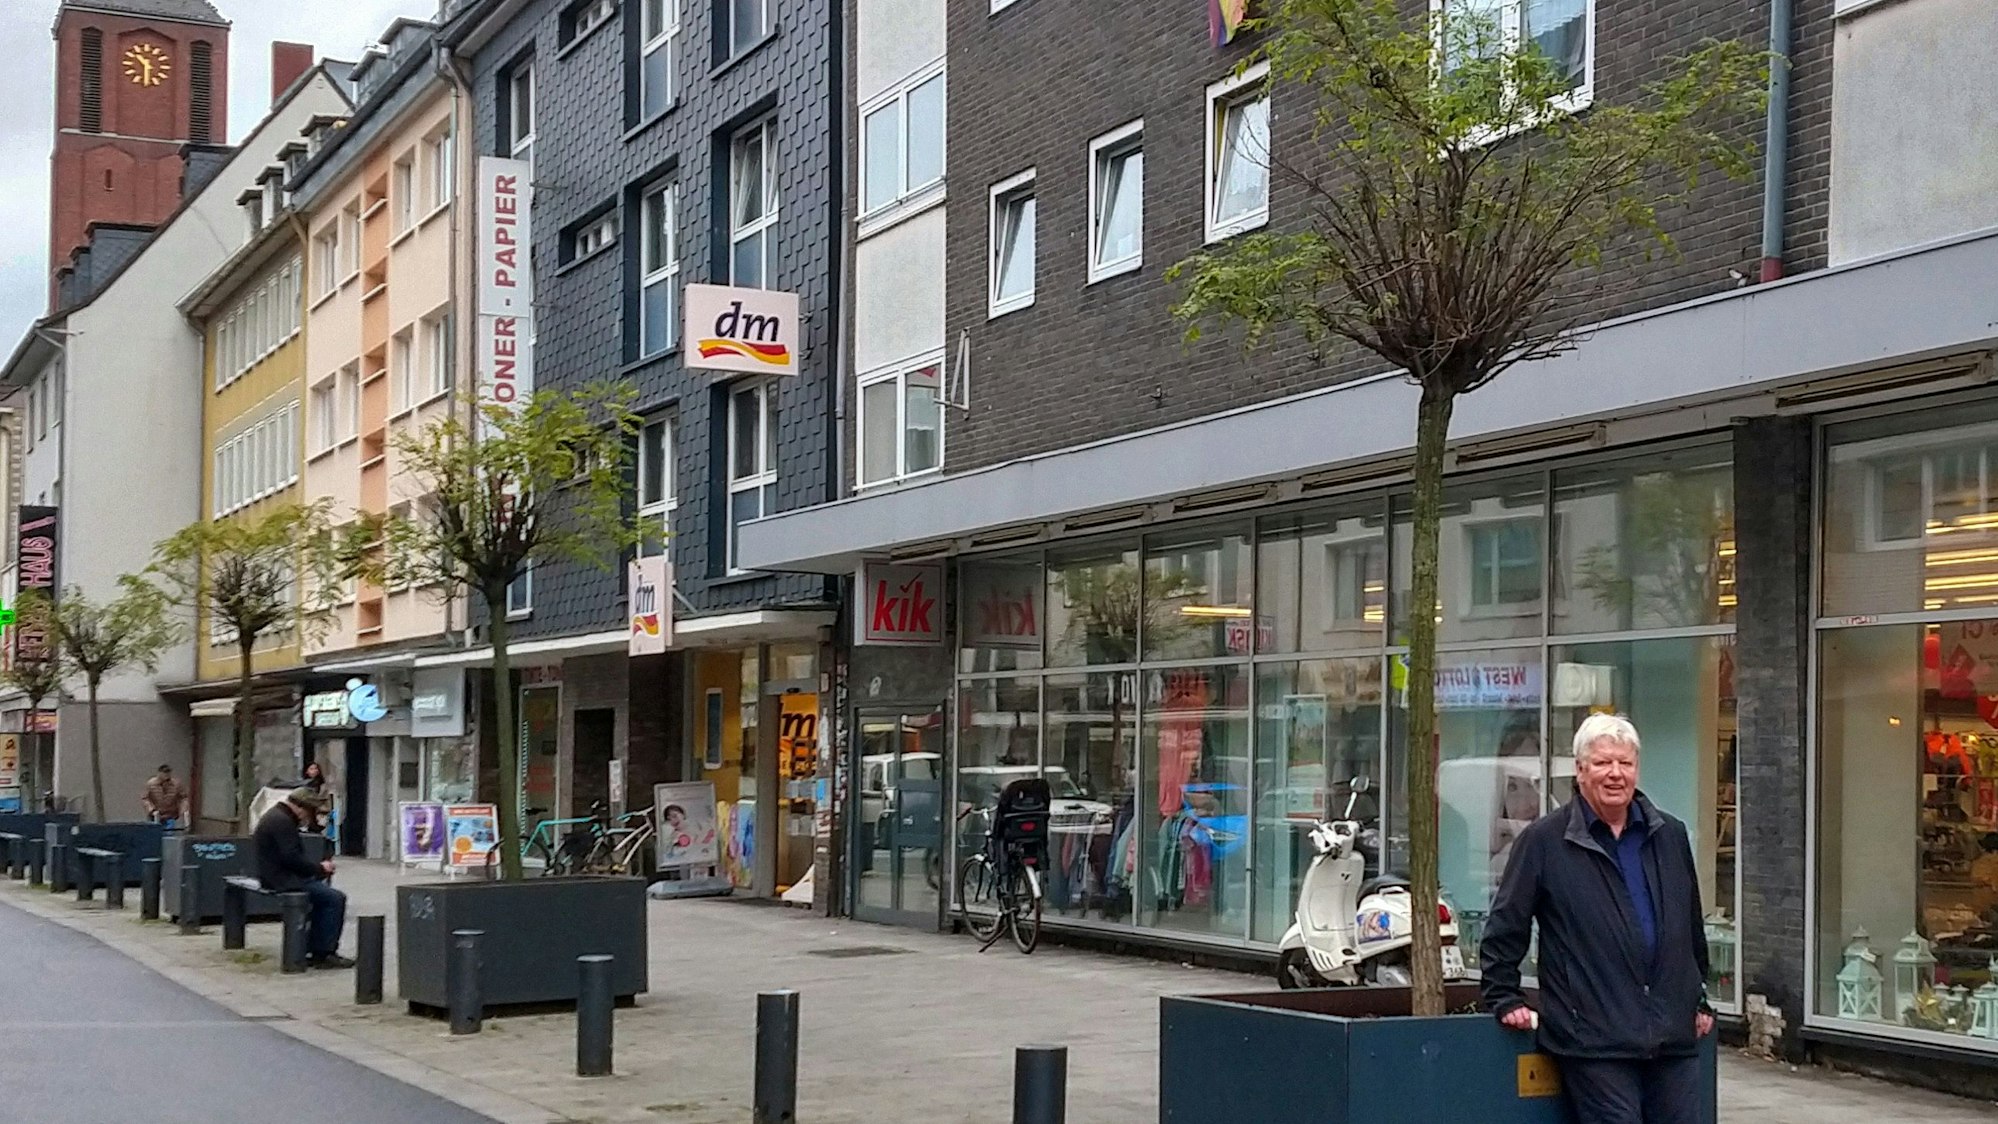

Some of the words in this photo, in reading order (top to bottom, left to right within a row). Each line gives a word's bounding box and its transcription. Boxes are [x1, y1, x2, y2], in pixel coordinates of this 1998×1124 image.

[495, 174, 517, 288] PAPIER
[714, 301, 780, 342] dm
[494, 316, 516, 407] ONER
[19, 536, 54, 587] HAUS
[634, 573, 656, 614] dm
[873, 573, 936, 633] kik
[780, 702, 817, 738] m
